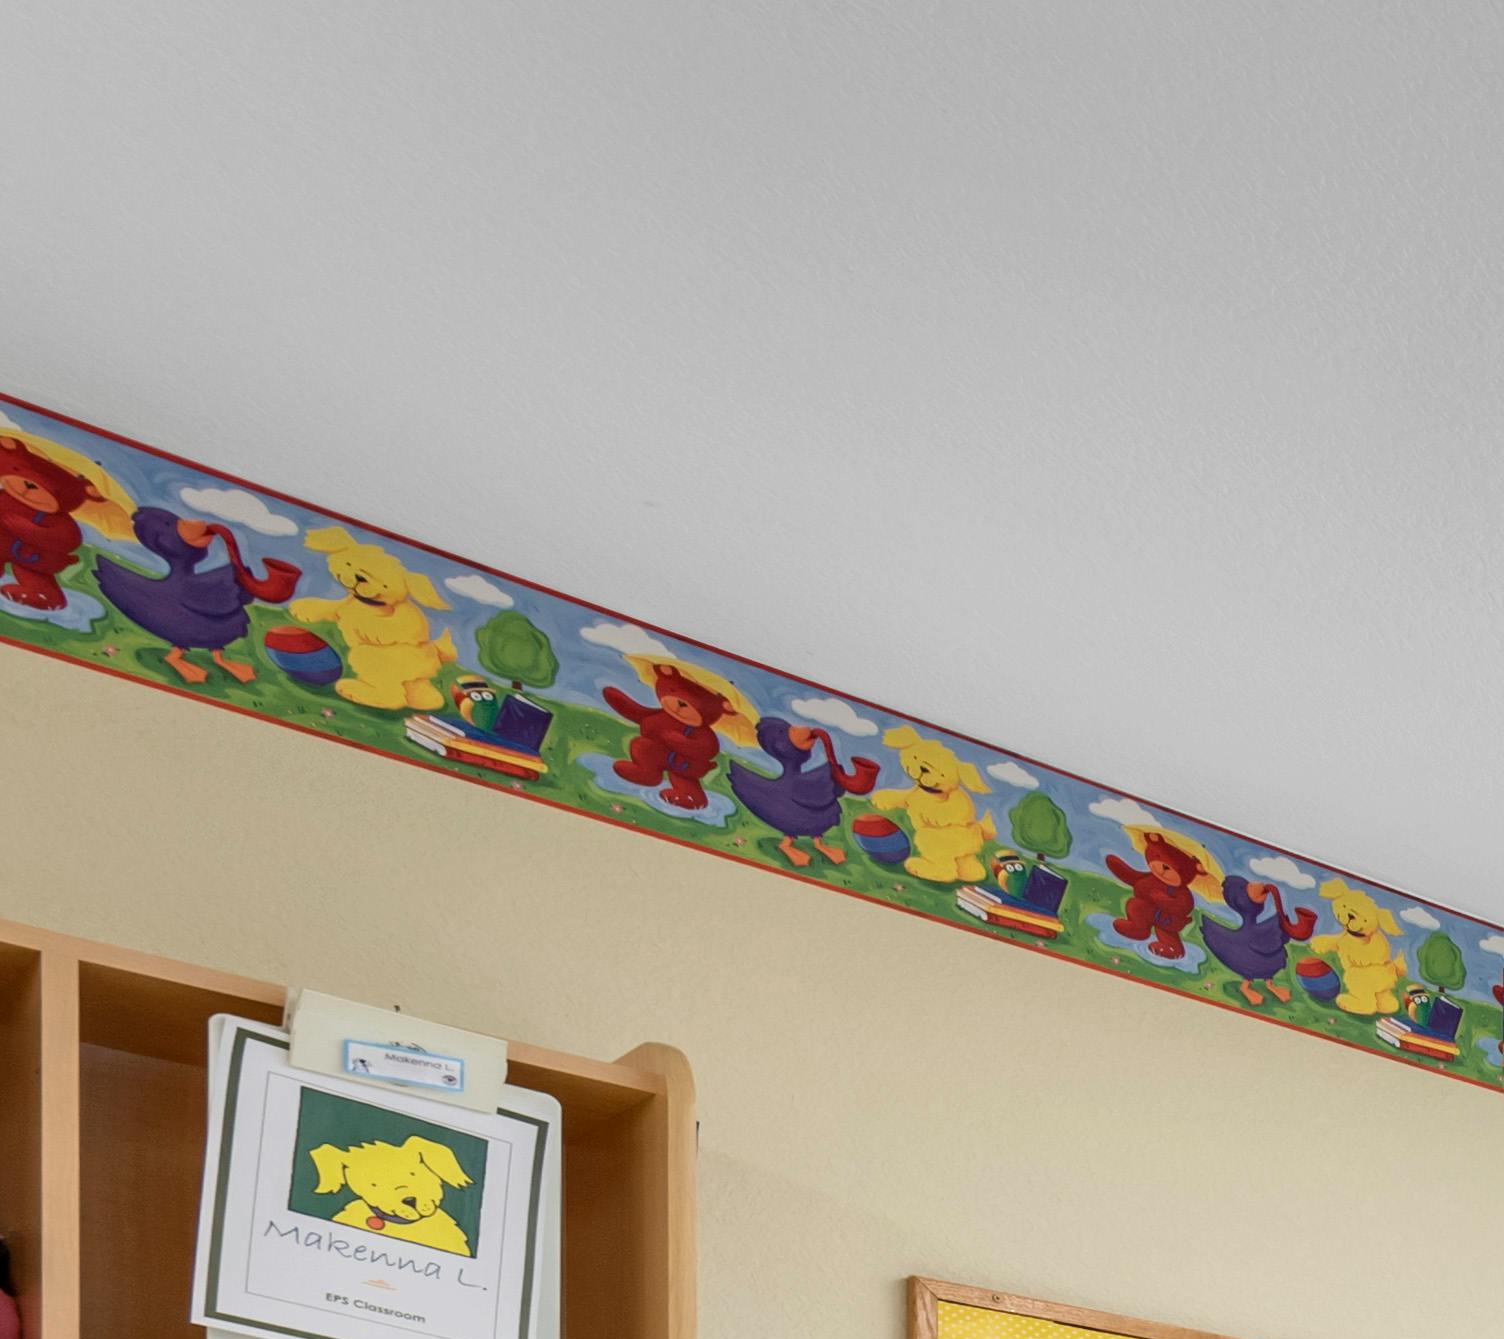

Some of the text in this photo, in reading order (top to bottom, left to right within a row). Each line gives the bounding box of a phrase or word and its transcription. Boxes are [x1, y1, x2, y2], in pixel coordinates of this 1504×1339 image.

[384, 1053, 441, 1070] Makenna
[263, 1219, 488, 1292] Makenna L.
[326, 1292, 427, 1325] EPS Classroom
